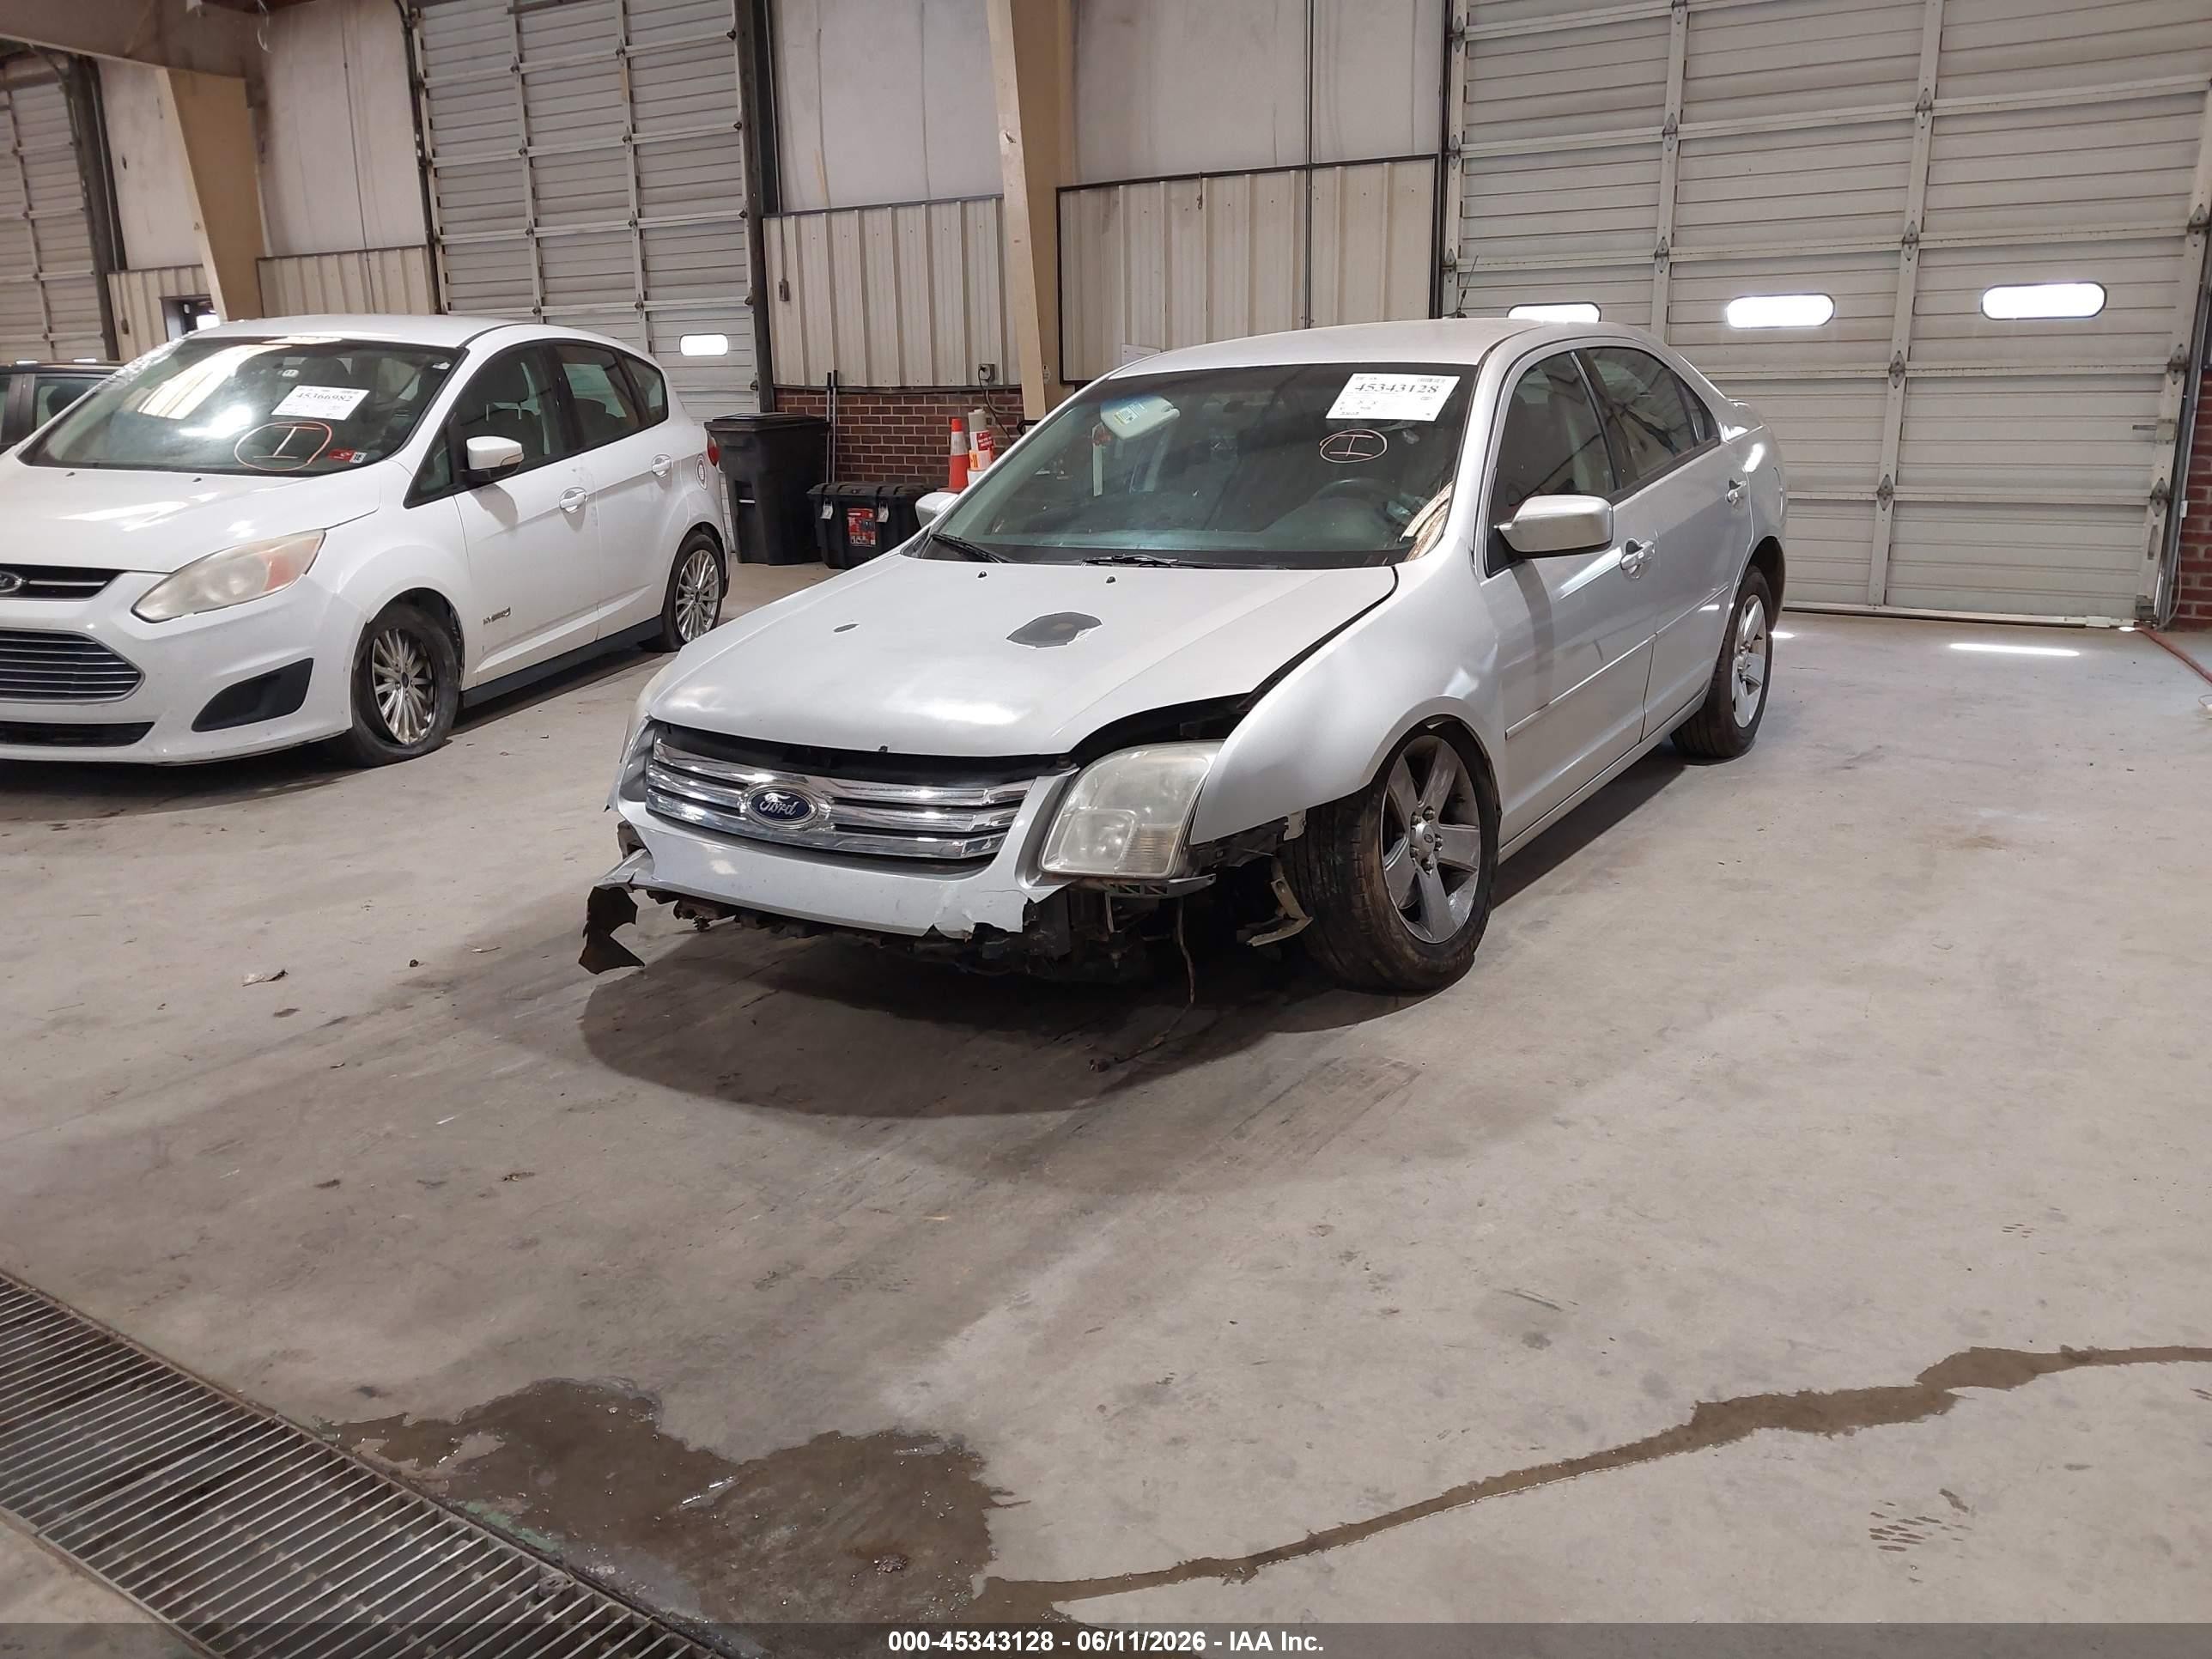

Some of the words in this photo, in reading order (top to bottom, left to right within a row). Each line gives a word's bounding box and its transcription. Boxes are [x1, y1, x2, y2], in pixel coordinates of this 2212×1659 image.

[1354, 383, 1439, 393] 45343128
[295, 392, 354, 402] 45366982
[759, 793, 799, 816] Ford
